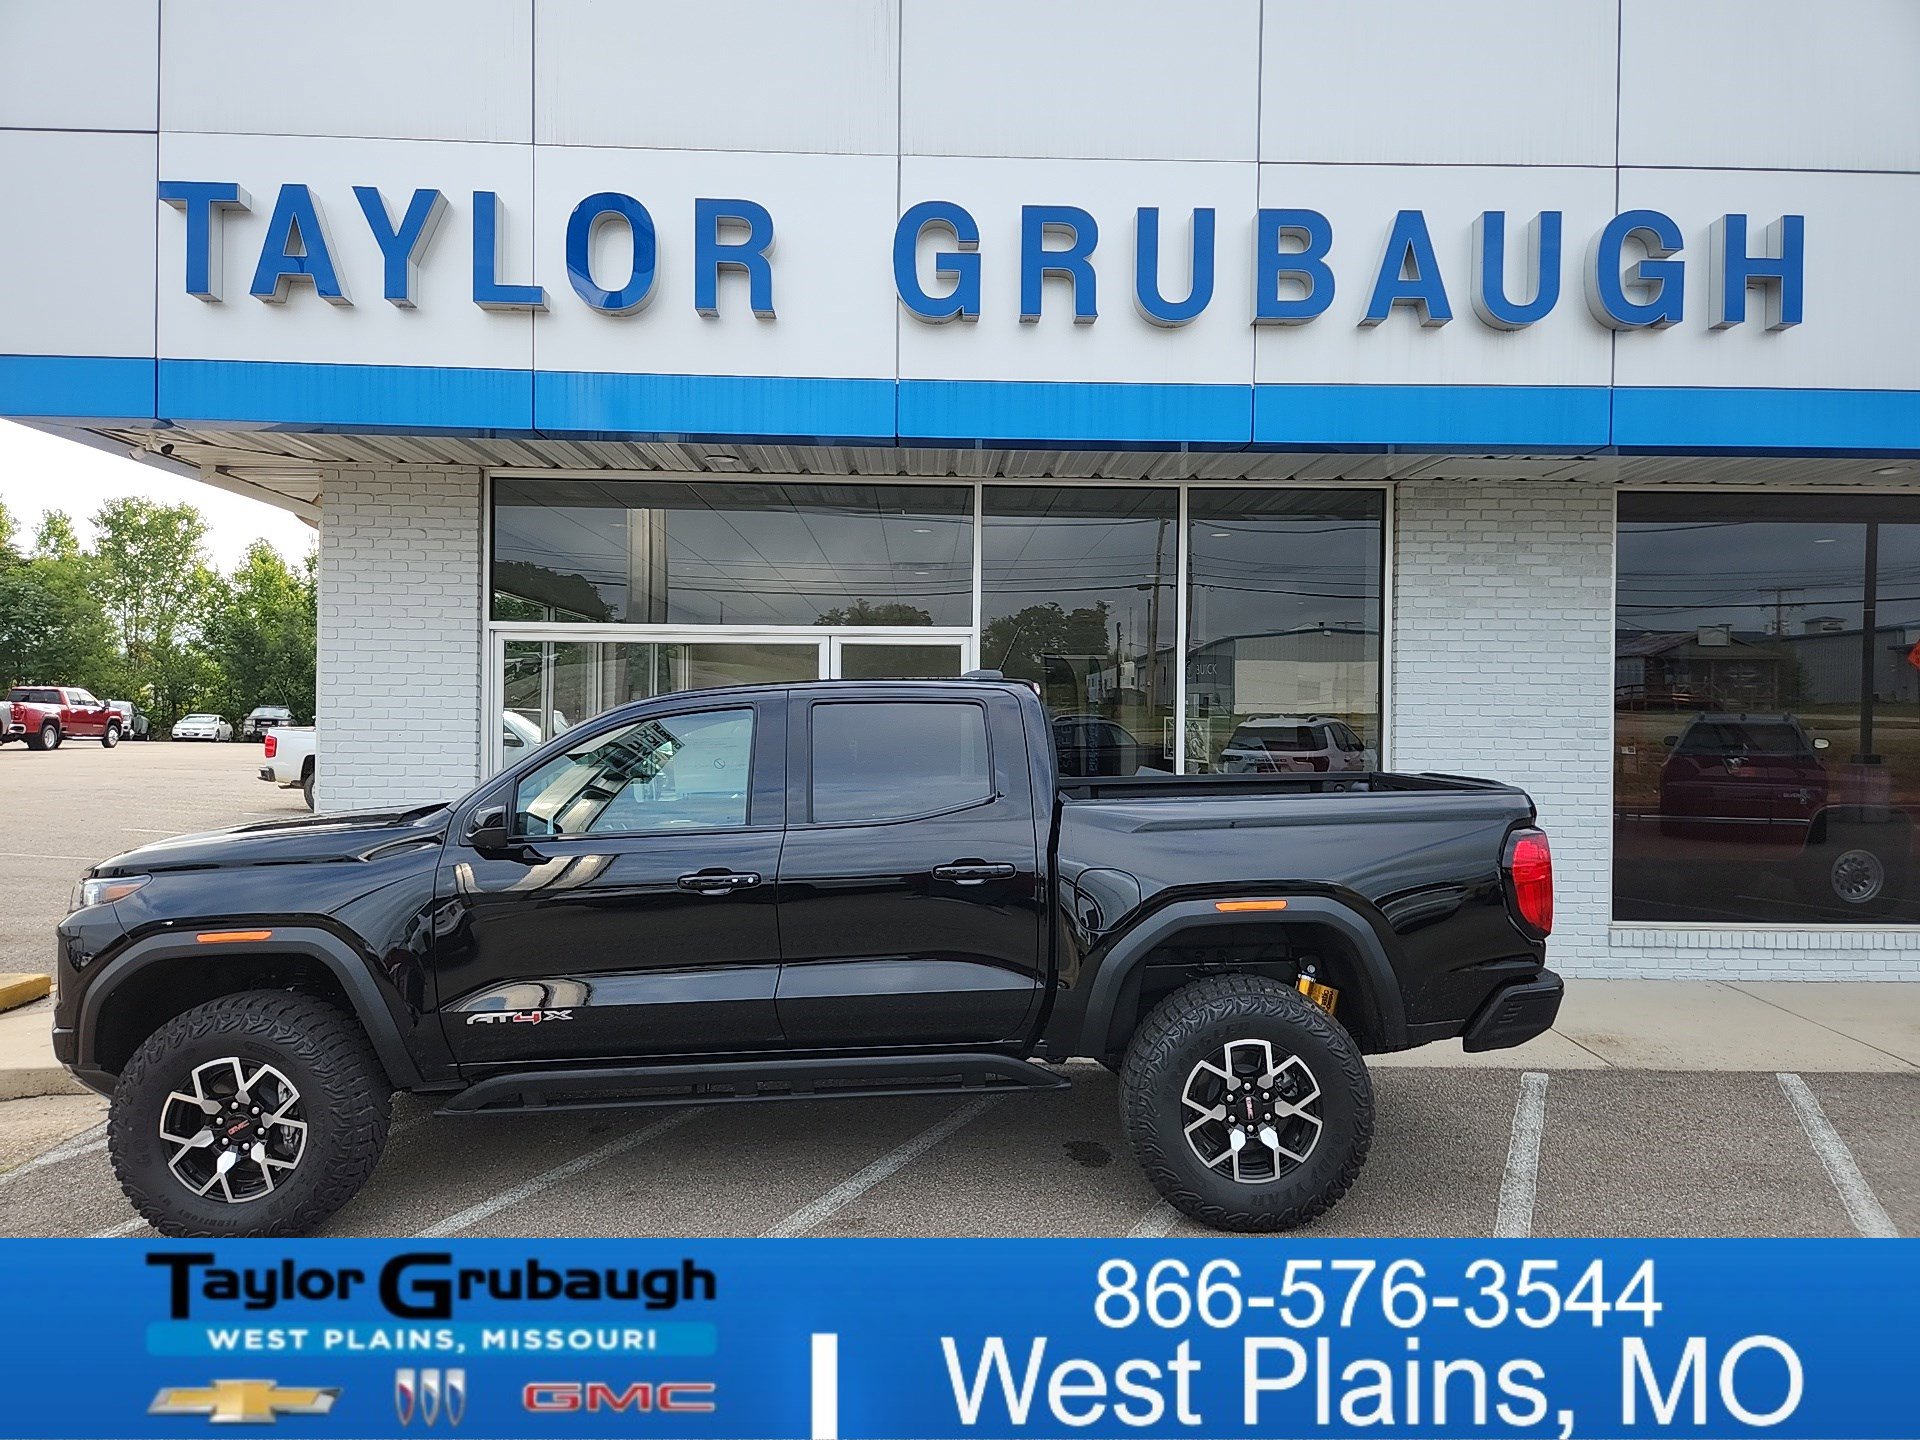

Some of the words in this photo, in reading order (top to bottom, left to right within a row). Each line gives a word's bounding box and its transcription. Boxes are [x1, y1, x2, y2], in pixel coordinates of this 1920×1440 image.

[157, 181, 776, 318] TAYLOR
[893, 202, 1804, 331] GRUBAUGH
[466, 1009, 574, 1025] AT4X
[227, 1119, 250, 1135] GMC
